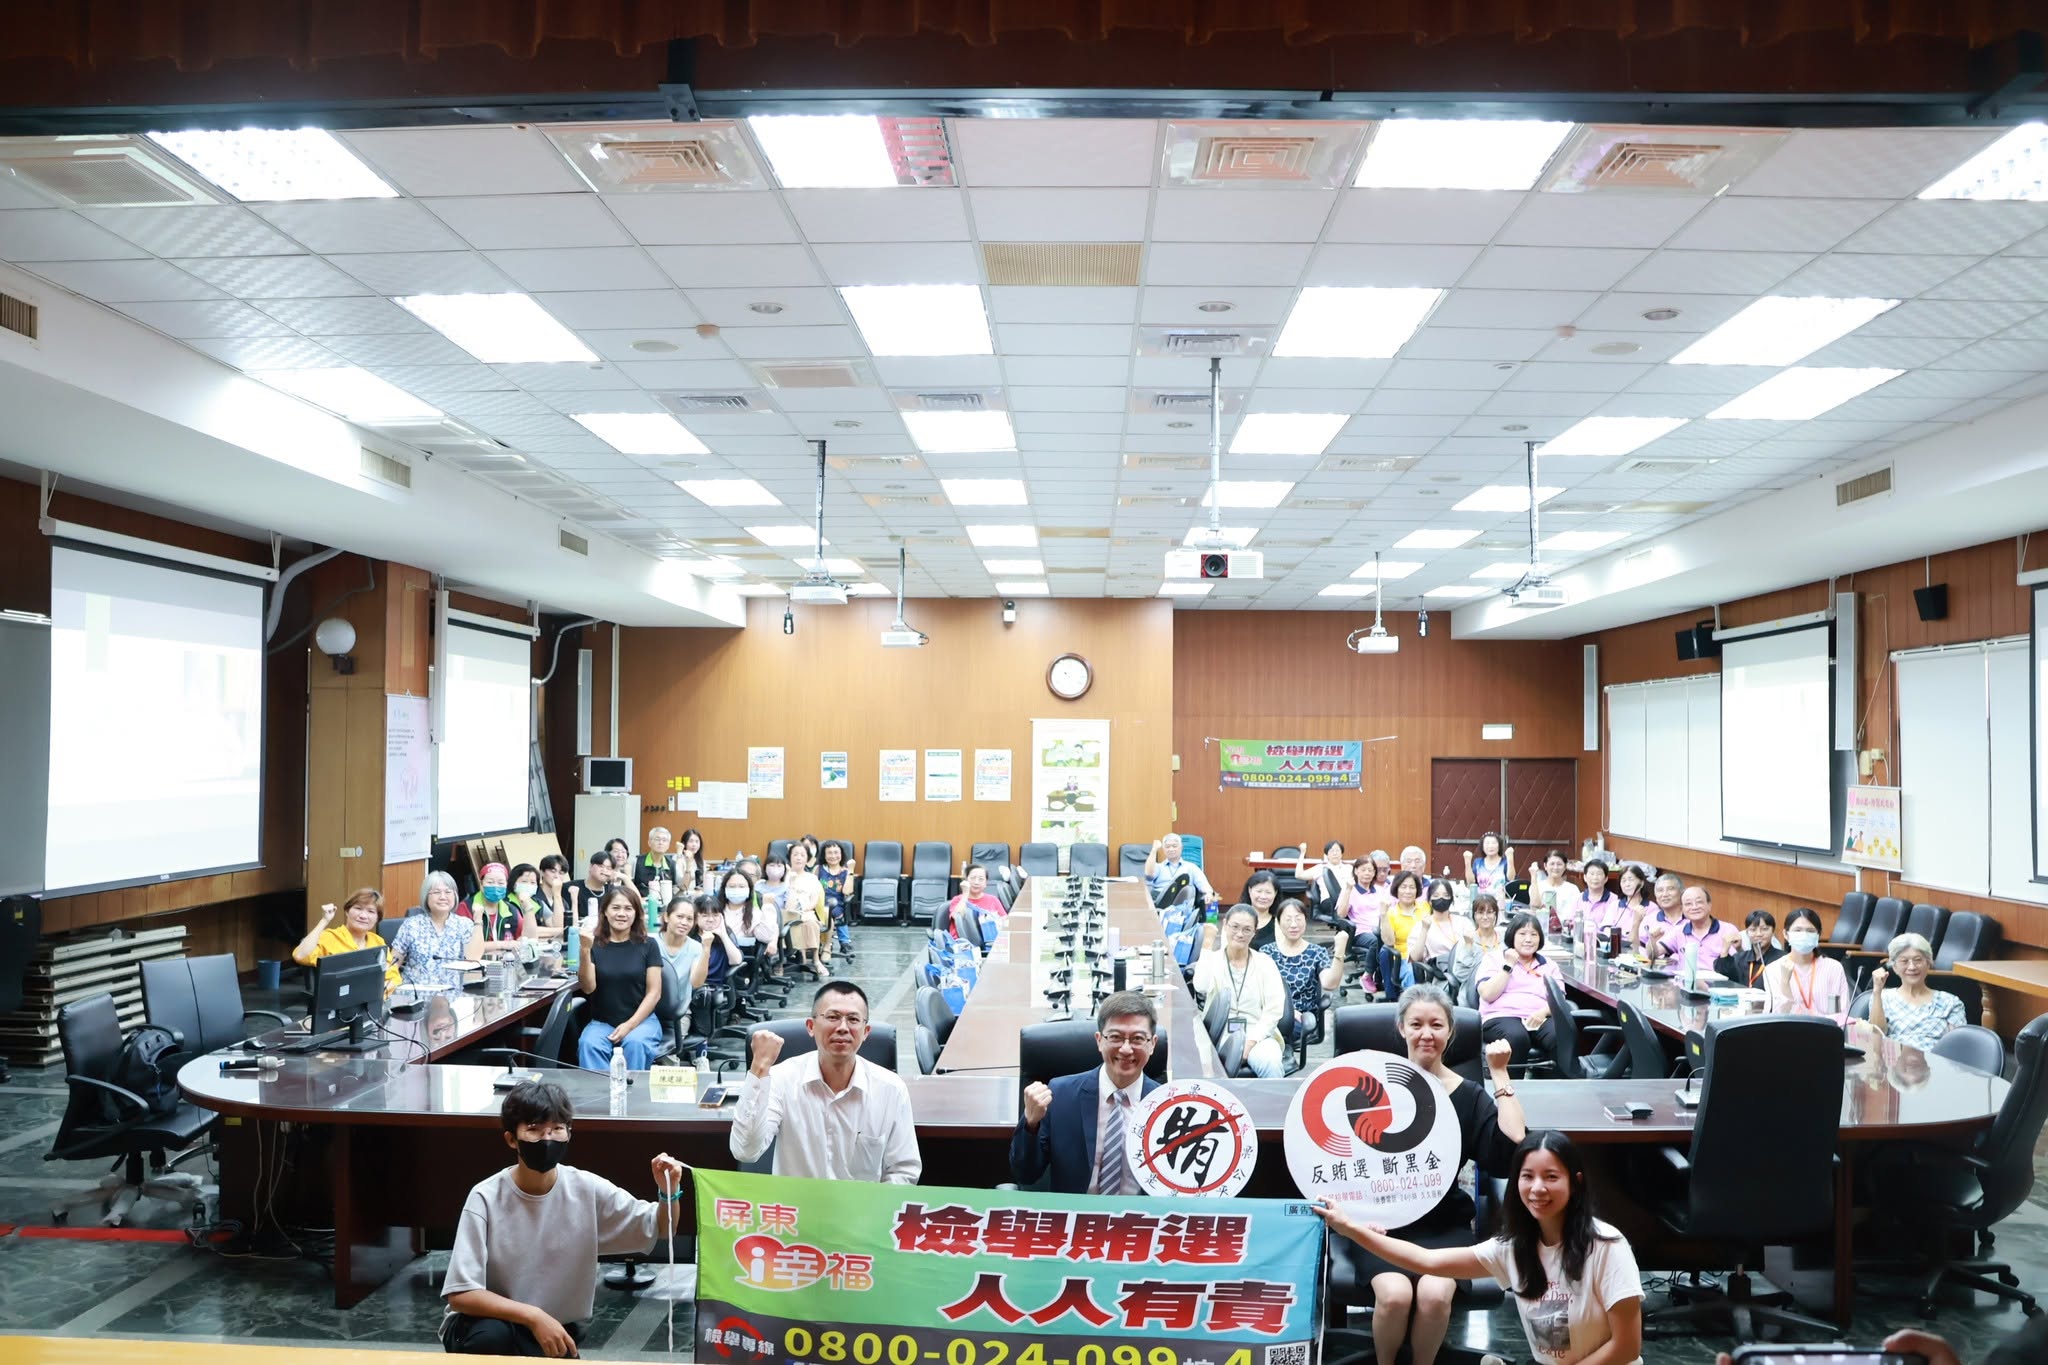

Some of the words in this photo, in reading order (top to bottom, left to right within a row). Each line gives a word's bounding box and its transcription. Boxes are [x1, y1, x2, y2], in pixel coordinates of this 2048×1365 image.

[1279, 760, 1354, 771] 人人有責
[1312, 1158, 1371, 1184] 反賄選
[1382, 1150, 1441, 1176] 斷黑金
[716, 1199, 799, 1235] 屏東
[895, 1203, 1248, 1264] 檢舉賄選
[941, 1274, 1294, 1334] 人人有責
[704, 1327, 775, 1356] 檢舉專線
[784, 1327, 1178, 1365] 0800-024-099
